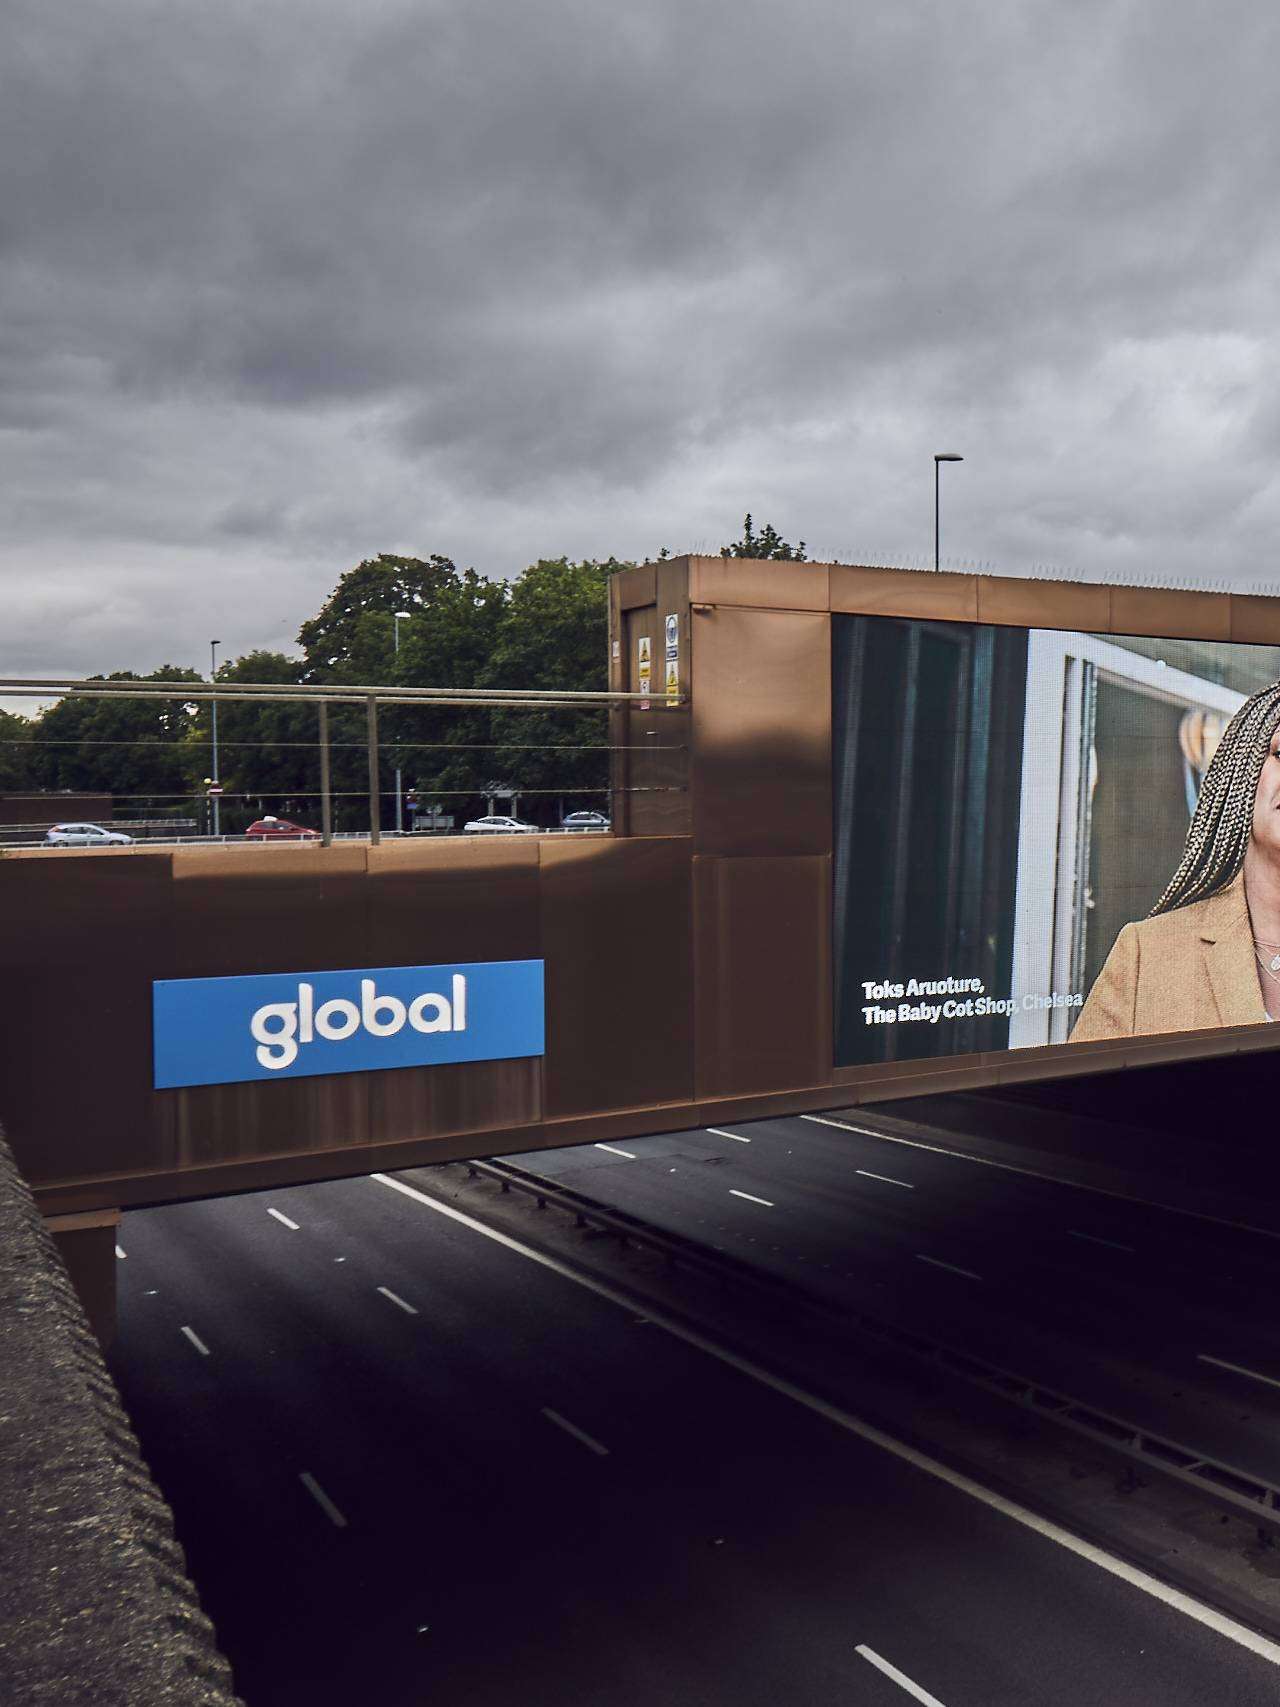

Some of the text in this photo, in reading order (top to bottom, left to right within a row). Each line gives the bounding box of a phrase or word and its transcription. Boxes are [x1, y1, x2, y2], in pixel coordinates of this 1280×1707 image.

[861, 976, 985, 1001] Toks Aruoture,
[251, 973, 466, 1069] global
[861, 1005, 897, 1026] The
[897, 1001, 942, 1024] Baby
[942, 998, 975, 1018] Cot
[1022, 991, 1084, 1011] Chelsea
